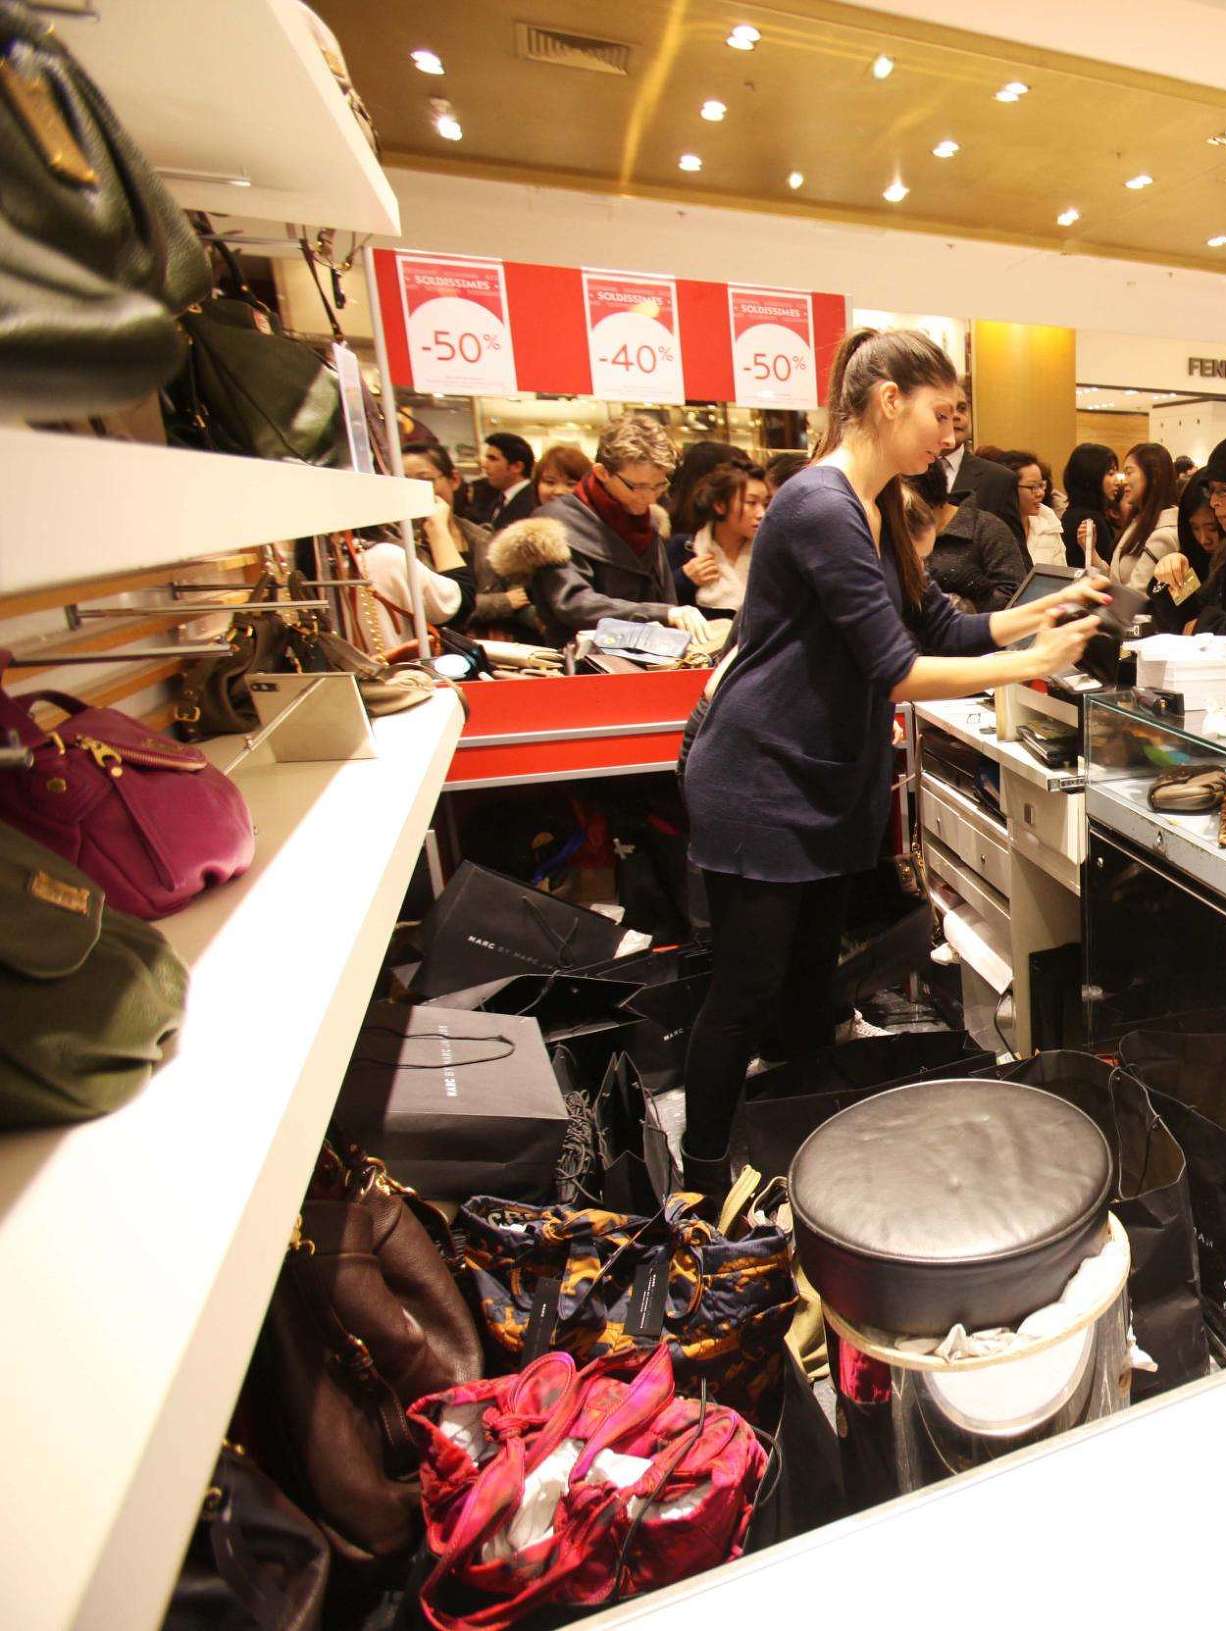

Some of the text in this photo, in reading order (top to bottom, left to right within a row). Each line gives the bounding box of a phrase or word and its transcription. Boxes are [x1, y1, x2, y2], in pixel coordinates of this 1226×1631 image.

[421, 330, 501, 364] -50%
[599, 343, 674, 374] -40%
[743, 353, 808, 382] -50%
[467, 935, 496, 950] MARC
[446, 1078, 458, 1097] MARC
